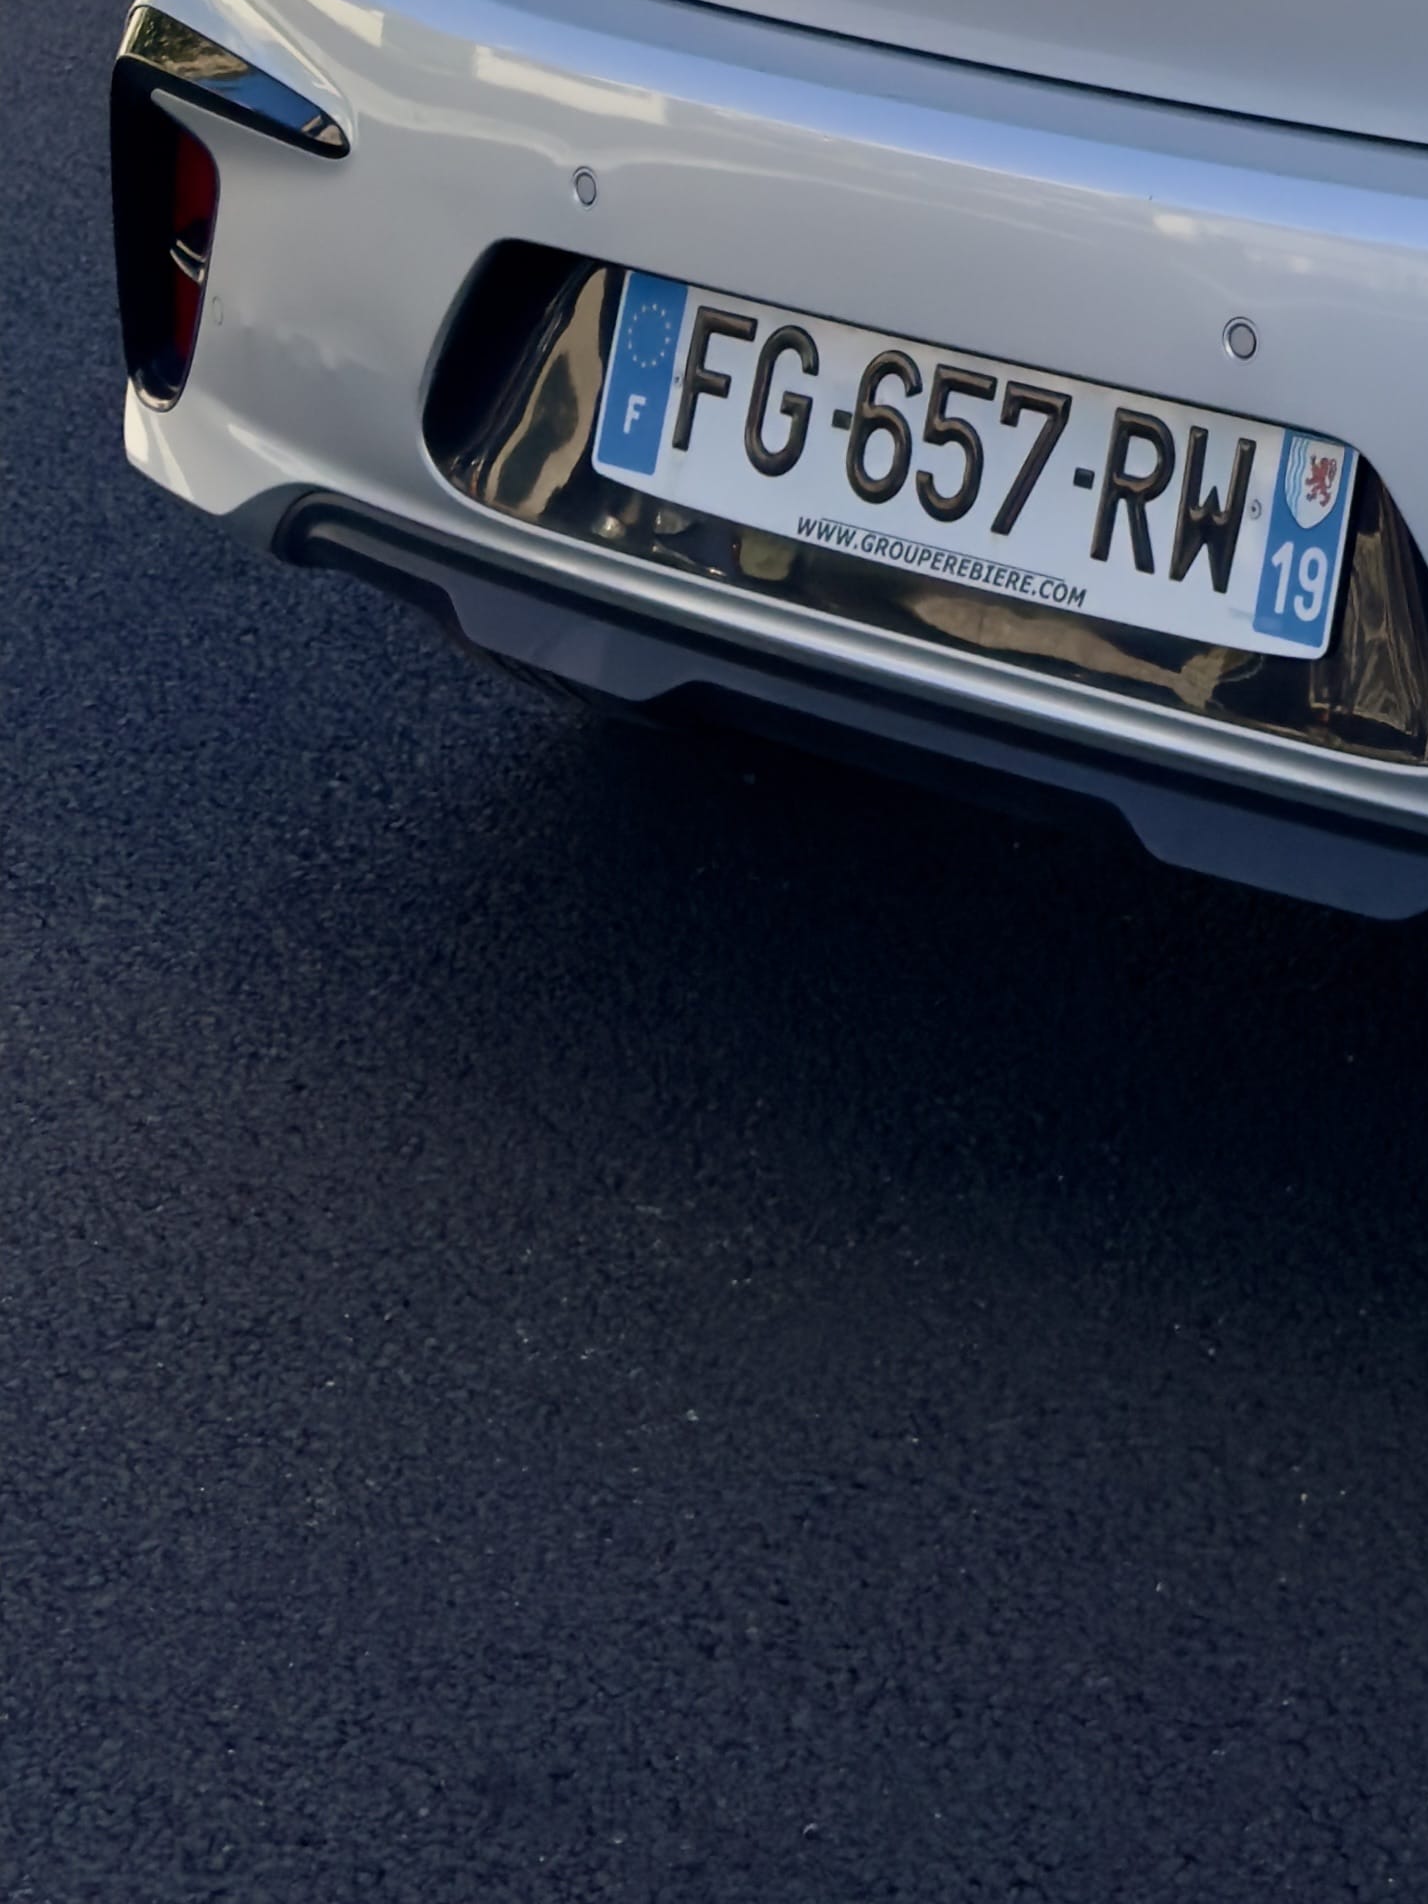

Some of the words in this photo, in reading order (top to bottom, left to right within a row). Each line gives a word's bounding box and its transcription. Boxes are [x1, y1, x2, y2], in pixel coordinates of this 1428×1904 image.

[621, 392, 648, 435] F
[670, 304, 1258, 595] FG-657-RW
[796, 516, 1088, 608] WWW.GROUPEREBIERE.COM
[1269, 539, 1326, 625] 19
